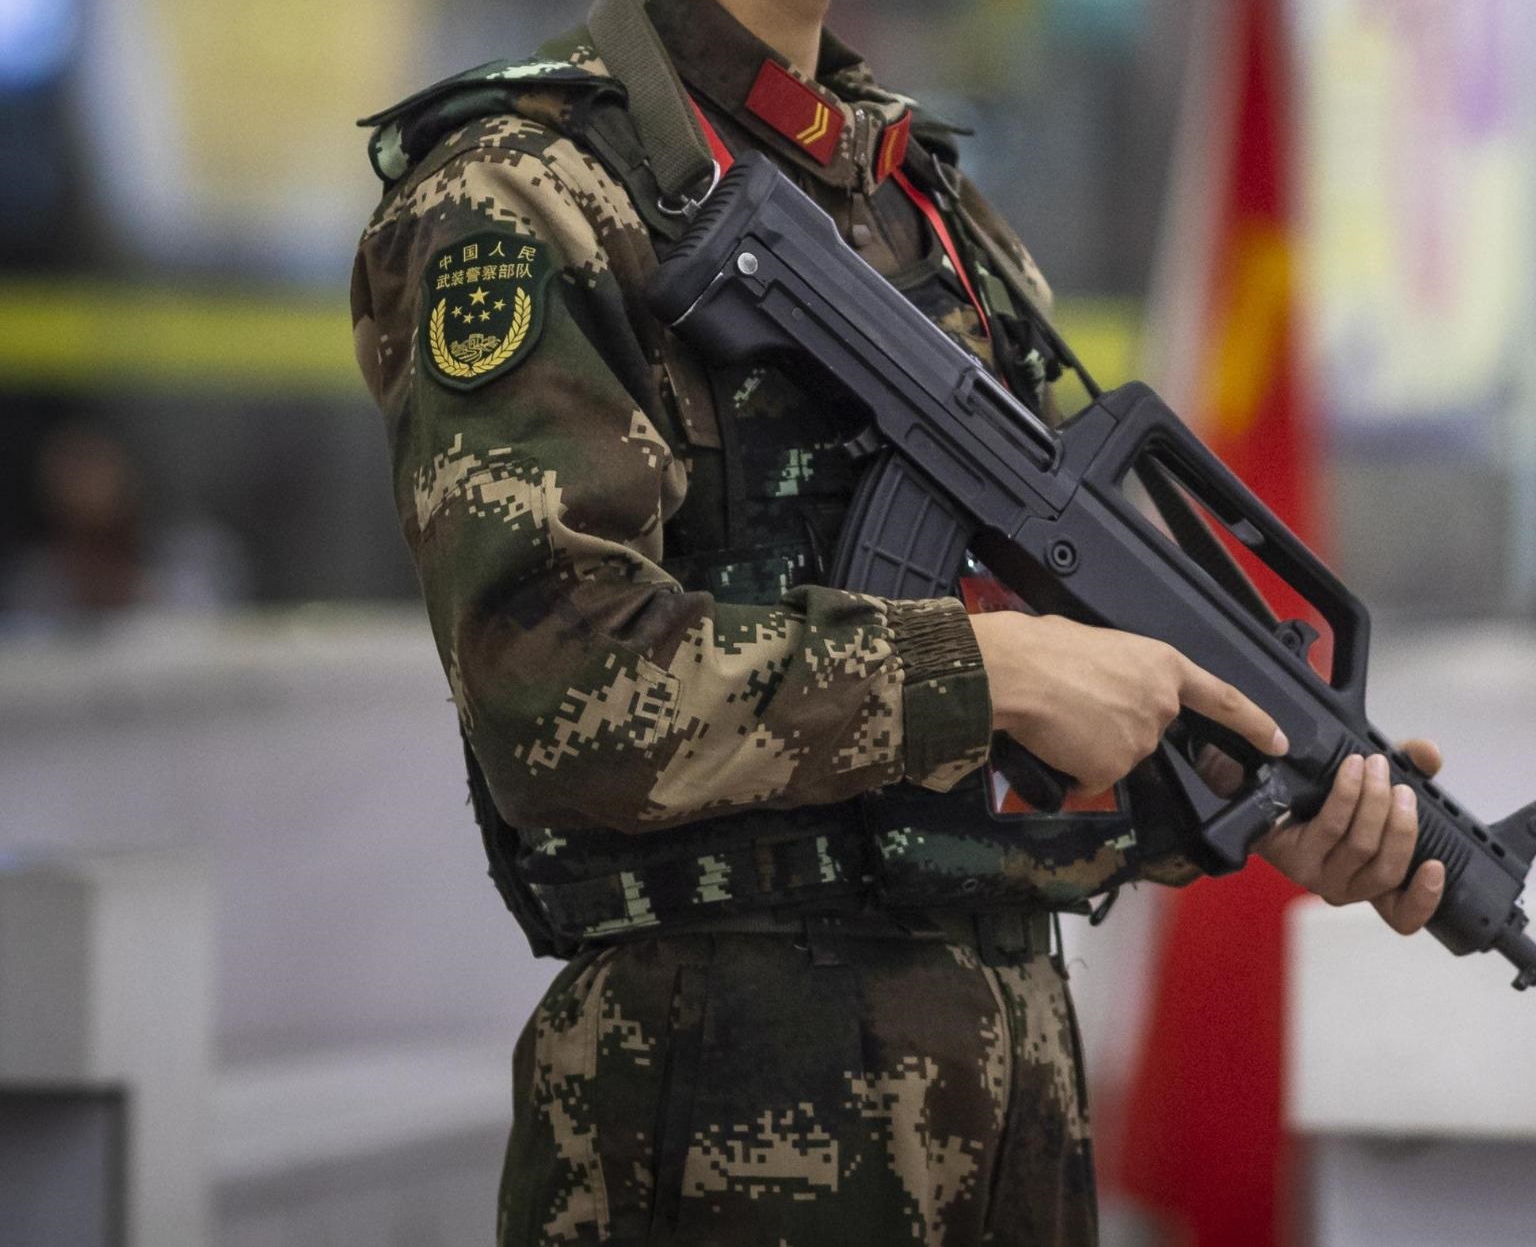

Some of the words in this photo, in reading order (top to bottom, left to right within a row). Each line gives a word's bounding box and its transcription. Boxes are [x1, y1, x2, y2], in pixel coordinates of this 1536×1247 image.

[438, 241, 537, 270] 中国人民
[436, 263, 533, 290] 武装警察部队
